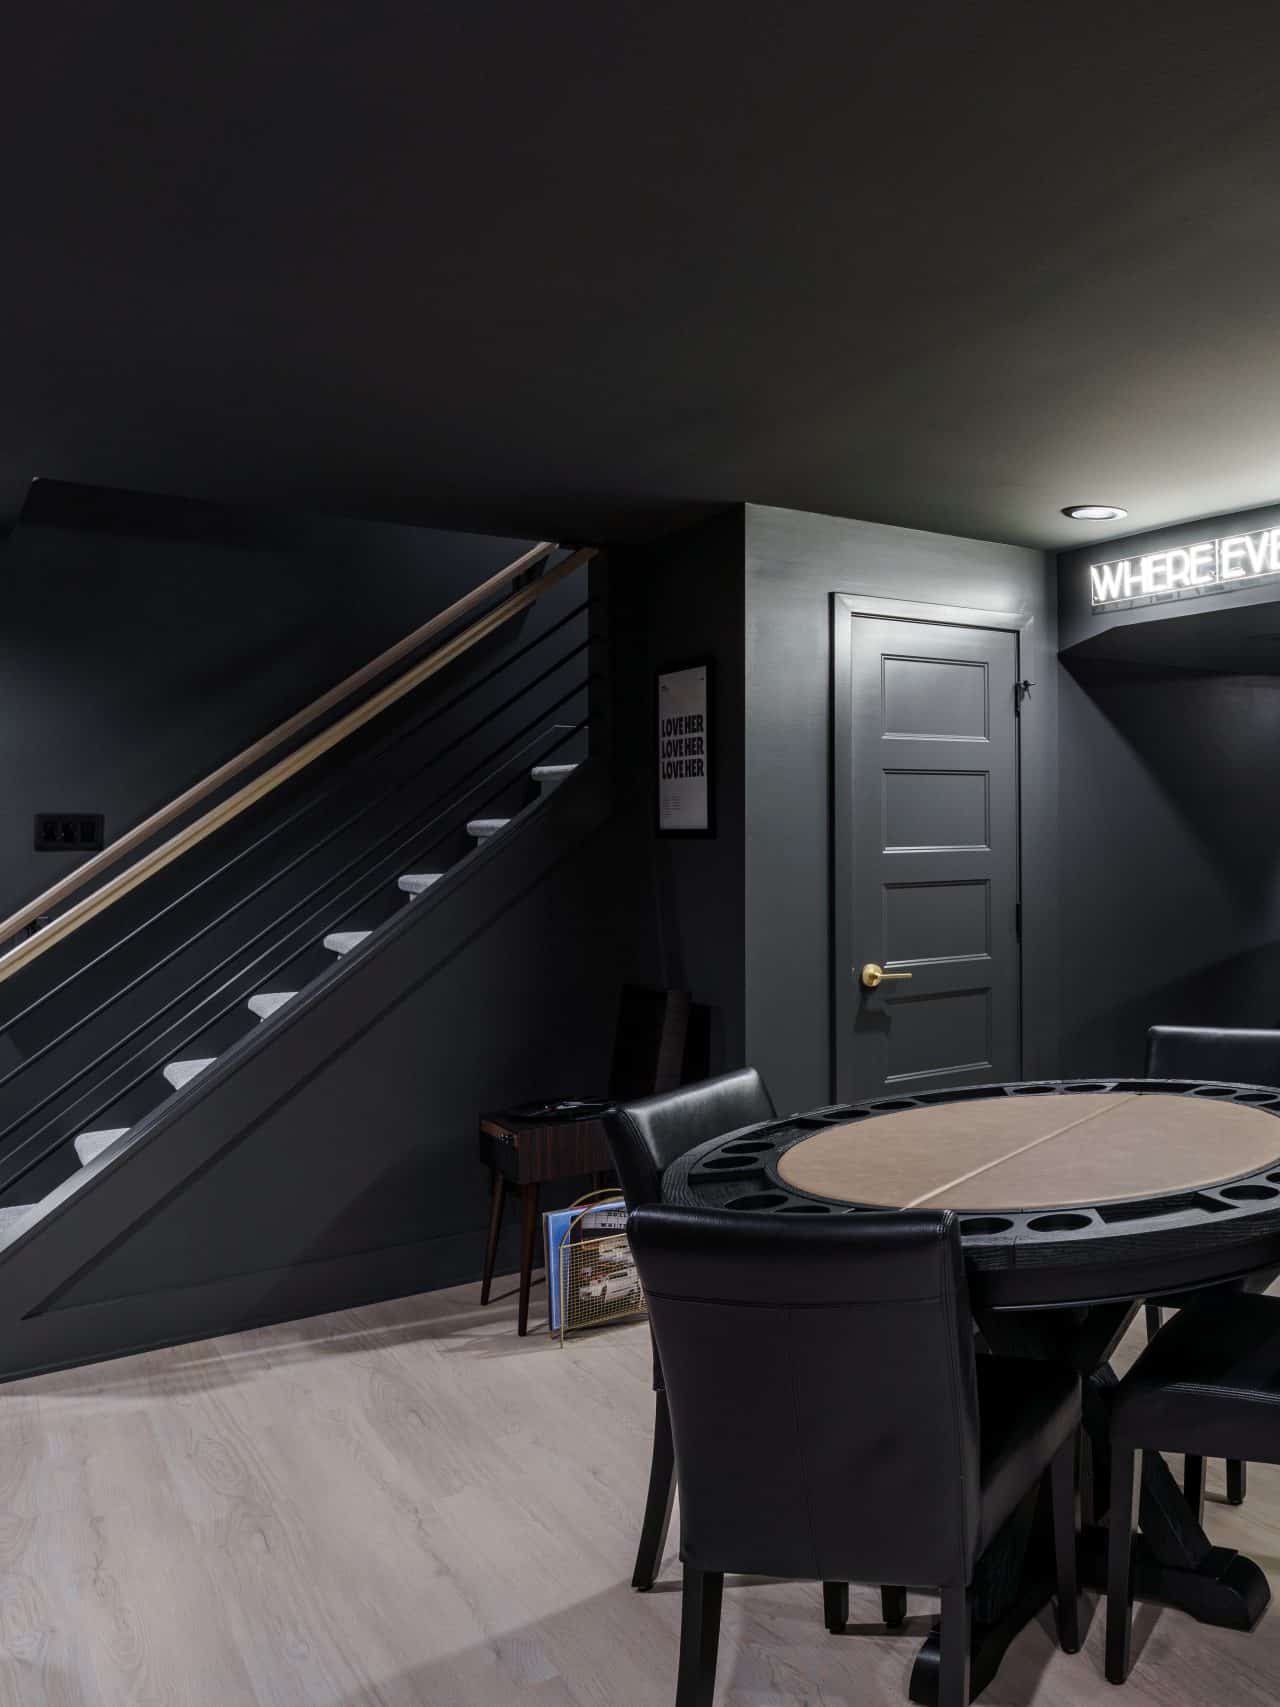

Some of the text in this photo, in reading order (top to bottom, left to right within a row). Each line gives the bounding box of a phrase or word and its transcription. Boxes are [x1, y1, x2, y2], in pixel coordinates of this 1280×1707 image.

[1091, 543, 1214, 601] WHERE
[662, 714, 704, 737] LOVE HER
[662, 736, 704, 758] LOVE HER
[662, 757, 704, 779] LOVE HER
